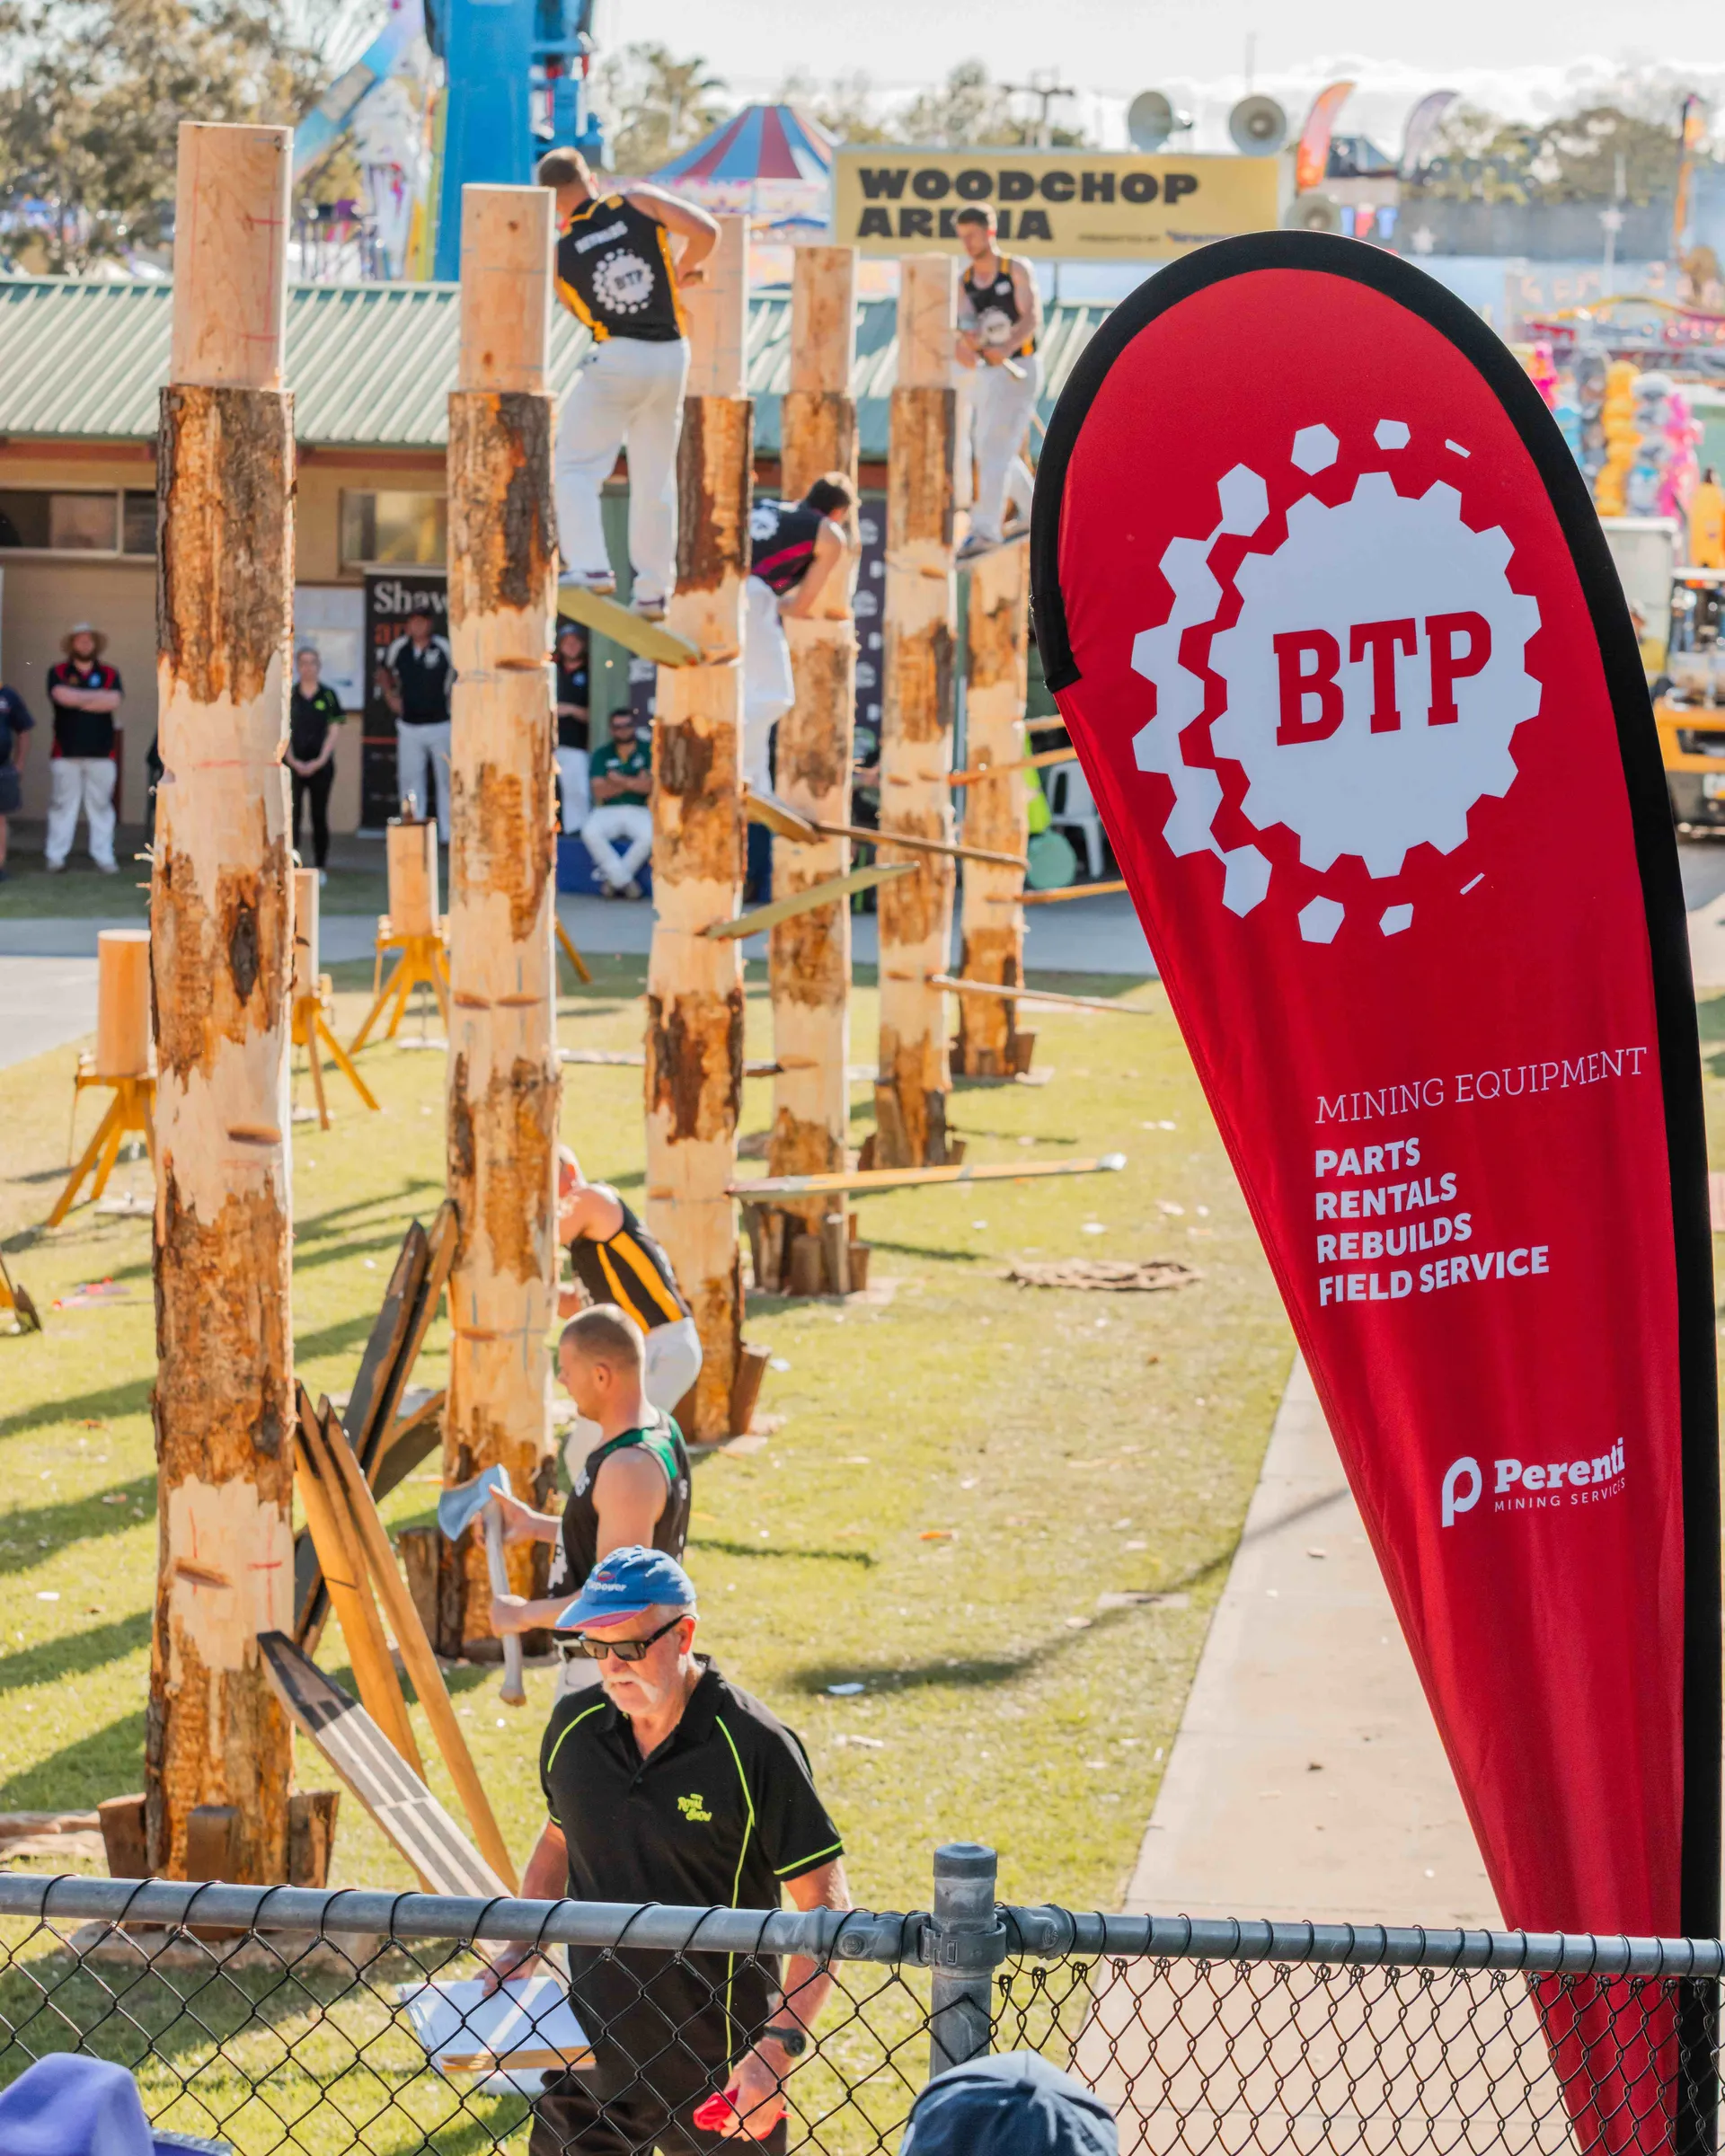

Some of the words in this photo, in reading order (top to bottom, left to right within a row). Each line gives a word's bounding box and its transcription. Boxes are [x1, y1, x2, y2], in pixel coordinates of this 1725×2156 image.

[858, 168, 1199, 204] WOODCHOP
[1273, 611, 1491, 746] BTP
[1315, 1078, 1444, 1124] MINING
[1455, 1047, 1647, 1103] EQUIPMENT
[1315, 1137, 1420, 1178] PARTS
[1315, 1172, 1457, 1221] RENTALS
[1316, 1213, 1473, 1263] REBUILDS
[1319, 1269, 1413, 1307] FIELD
[1420, 1245, 1550, 1293] SERVICE
[1494, 1436, 1625, 1494] Perenti
[1494, 1495, 1561, 1513] MINING
[1570, 1477, 1625, 1505] SERVICES
